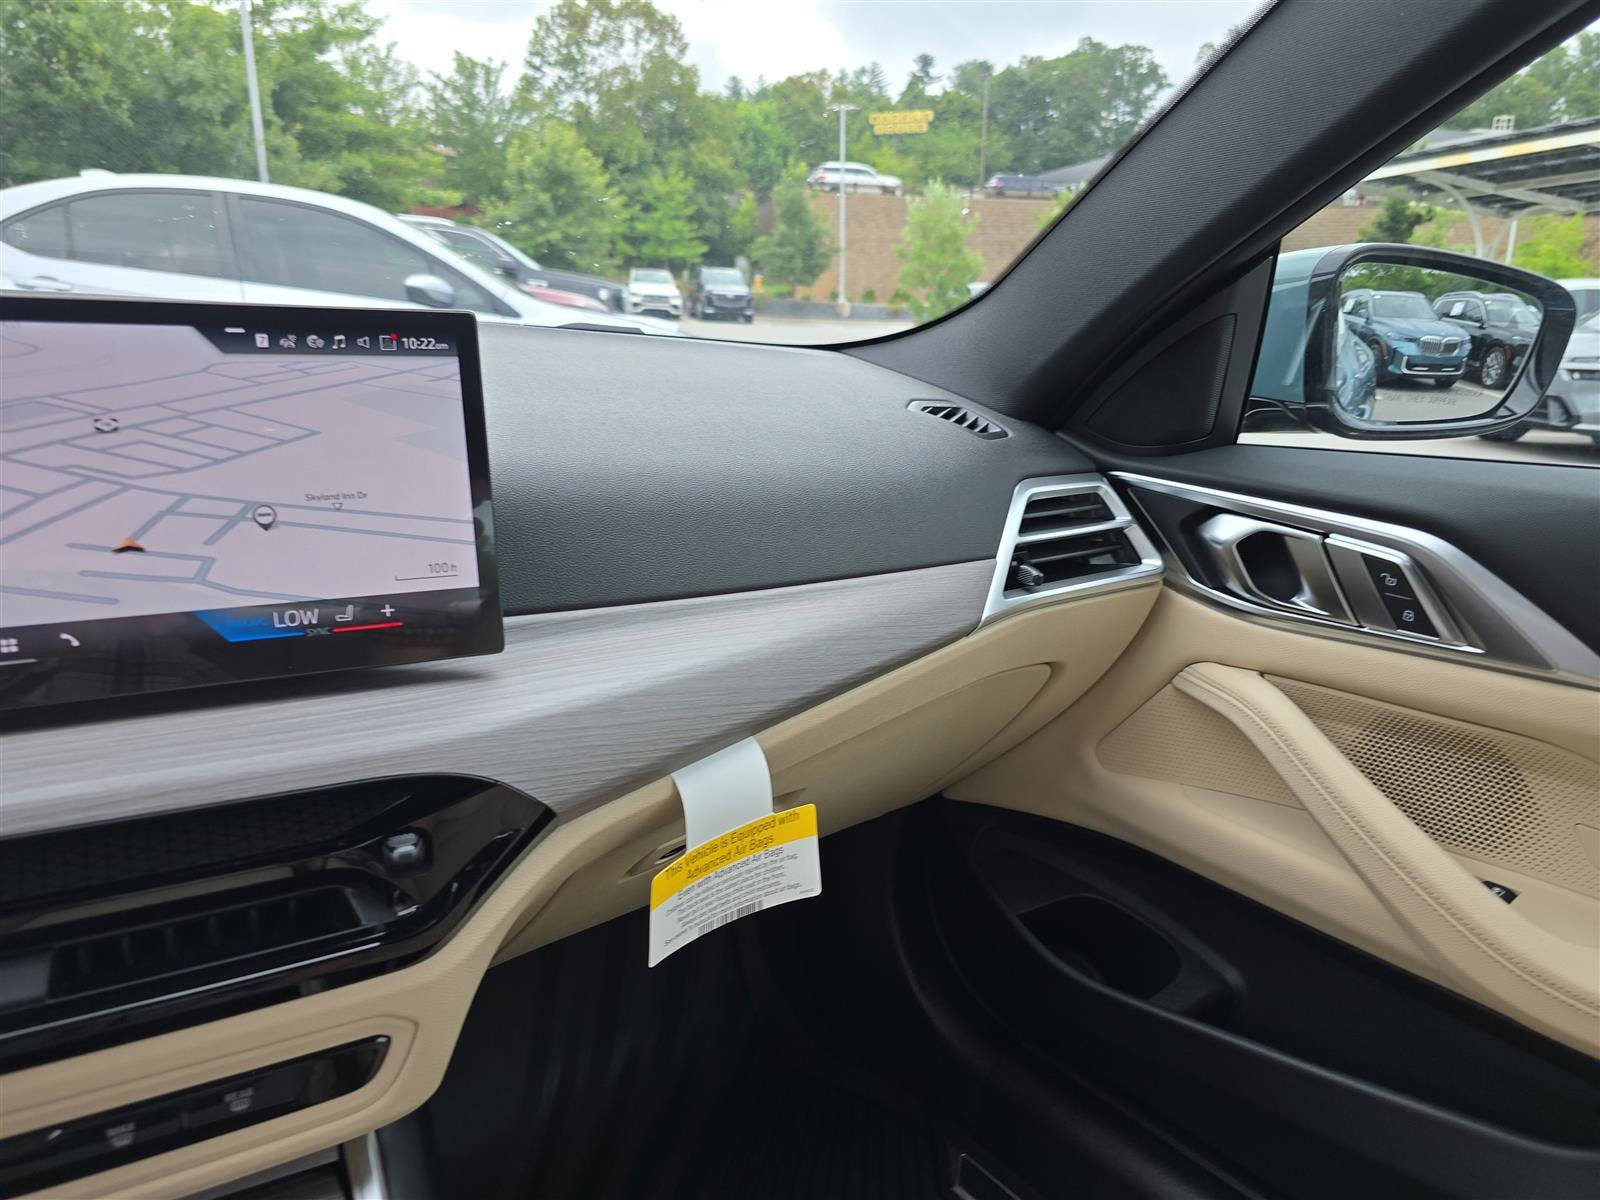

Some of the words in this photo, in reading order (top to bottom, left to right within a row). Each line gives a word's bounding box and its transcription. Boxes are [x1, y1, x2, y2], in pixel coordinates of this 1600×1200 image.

[305, 493, 340, 503] Skyland
[342, 492, 355, 500] Inn
[357, 491, 368, 499] Dr
[428, 562, 449, 574] 100
[273, 608, 320, 629] LOW
[665, 863, 684, 880] This
[685, 844, 719, 866] Vehicle
[720, 838, 729, 848] is
[731, 818, 776, 845] Equipped
[778, 811, 800, 825] with
[686, 852, 732, 881] Advanced
[734, 845, 748, 857] Air
[750, 835, 775, 851] Bags
[714, 859, 752, 880] Advanced
[752, 853, 763, 862] Air
[764, 847, 784, 860] Bags
